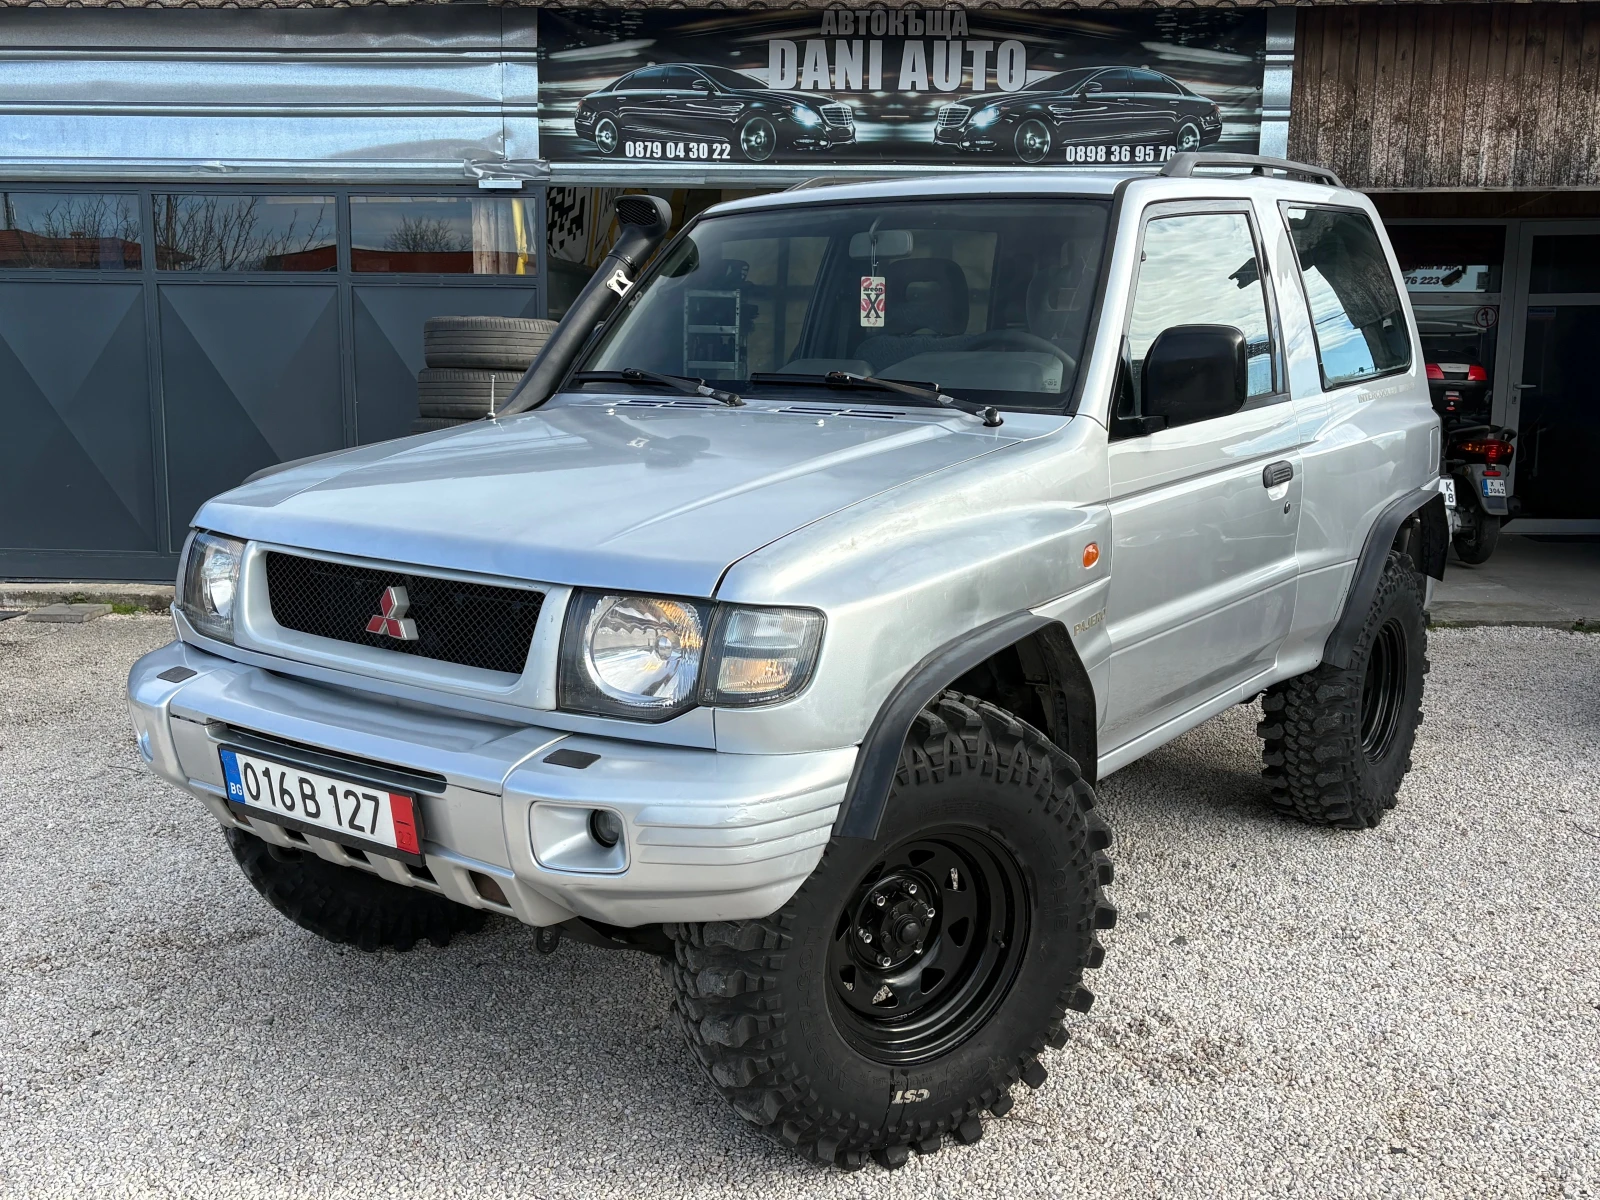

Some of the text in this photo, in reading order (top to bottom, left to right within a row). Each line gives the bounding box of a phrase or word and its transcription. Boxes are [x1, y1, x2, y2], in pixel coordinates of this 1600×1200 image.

[820, 10, 969, 40] АВТОКЪЩА
[768, 39, 1027, 92] DANI AUTO
[625, 141, 731, 159] 0879 04 30 22
[1066, 145, 1177, 162] 0898 36 95 76
[1404, 276, 1441, 285] 76 223
[863, 293, 883, 318] X
[1445, 481, 1453, 492] K
[230, 782, 243, 796] BG
[243, 761, 321, 819] 016B
[328, 784, 380, 835] 127
